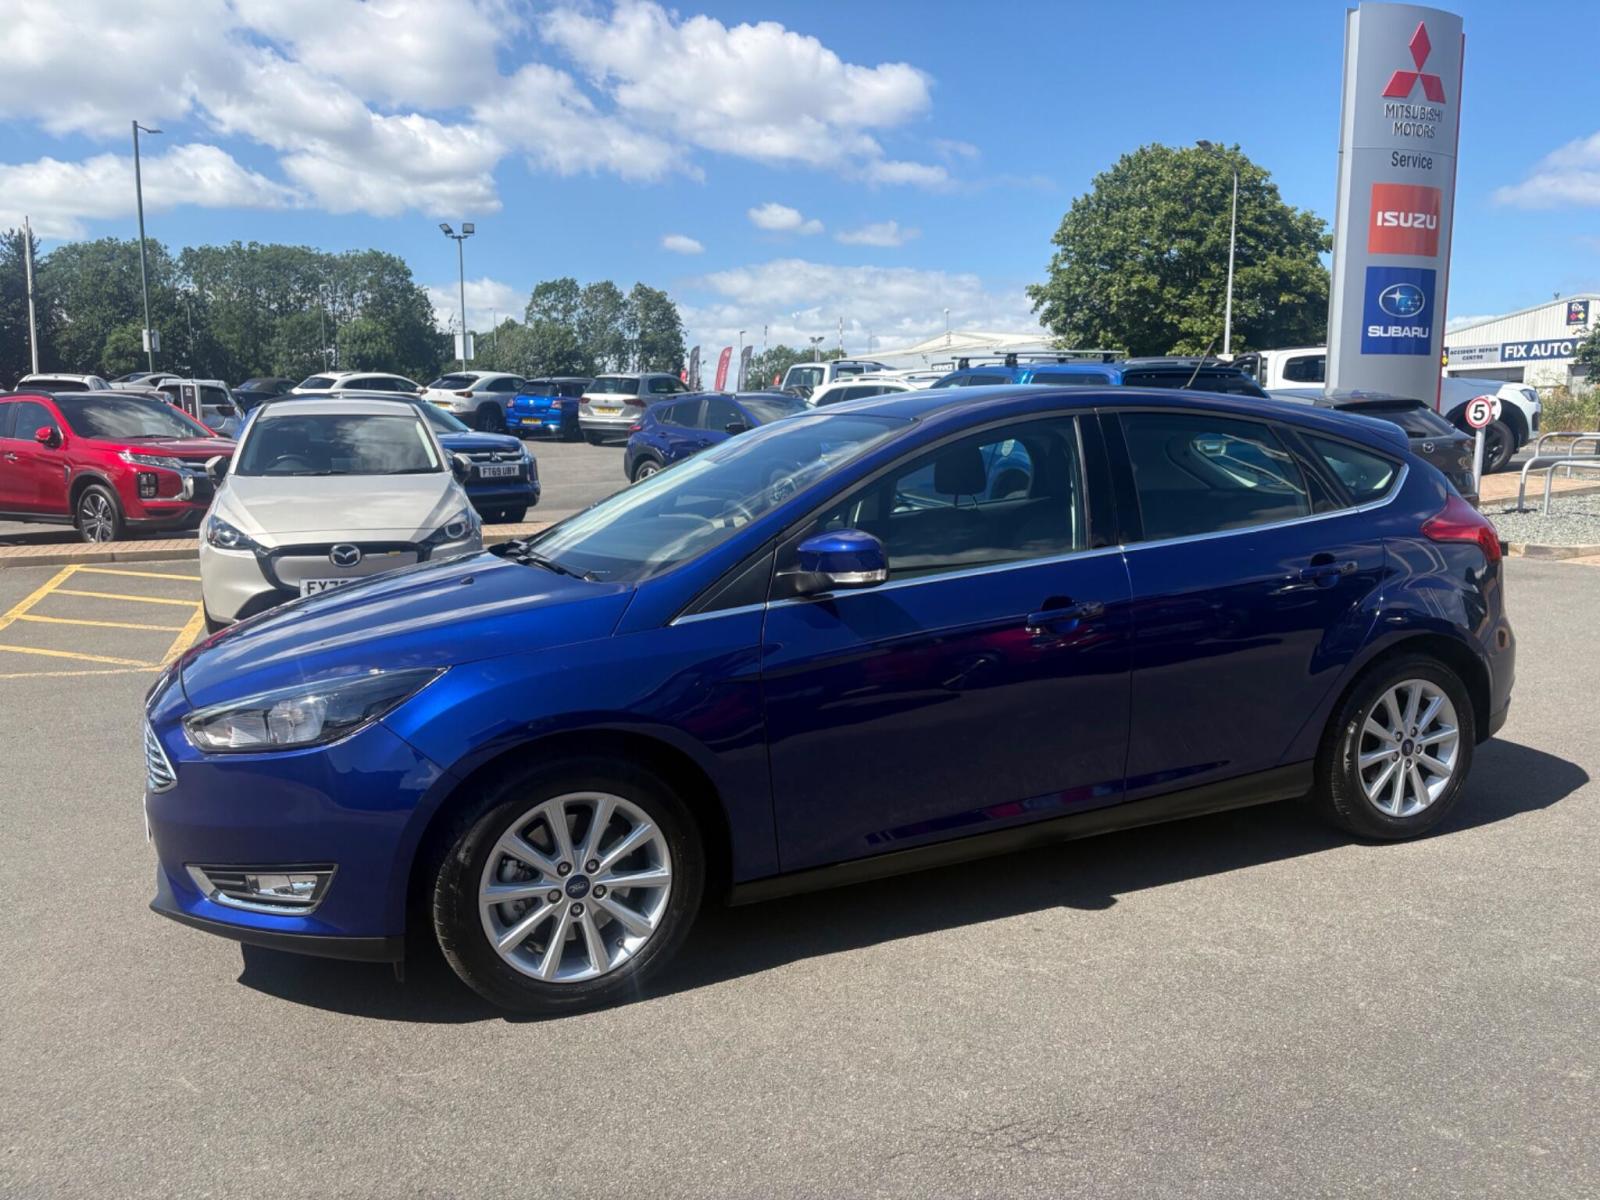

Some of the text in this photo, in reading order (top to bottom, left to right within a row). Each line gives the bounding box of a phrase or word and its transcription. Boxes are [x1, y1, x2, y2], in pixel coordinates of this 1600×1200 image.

[1384, 103, 1443, 122] MITSUBISHI
[1393, 121, 1436, 138] MOTORS
[1391, 151, 1433, 170] Service
[1376, 211, 1437, 230] ISUZU
[1367, 325, 1429, 338] SUBARU
[1504, 344, 1528, 359] FIX
[1530, 341, 1572, 357] AUTO
[1473, 404, 1485, 421] 5
